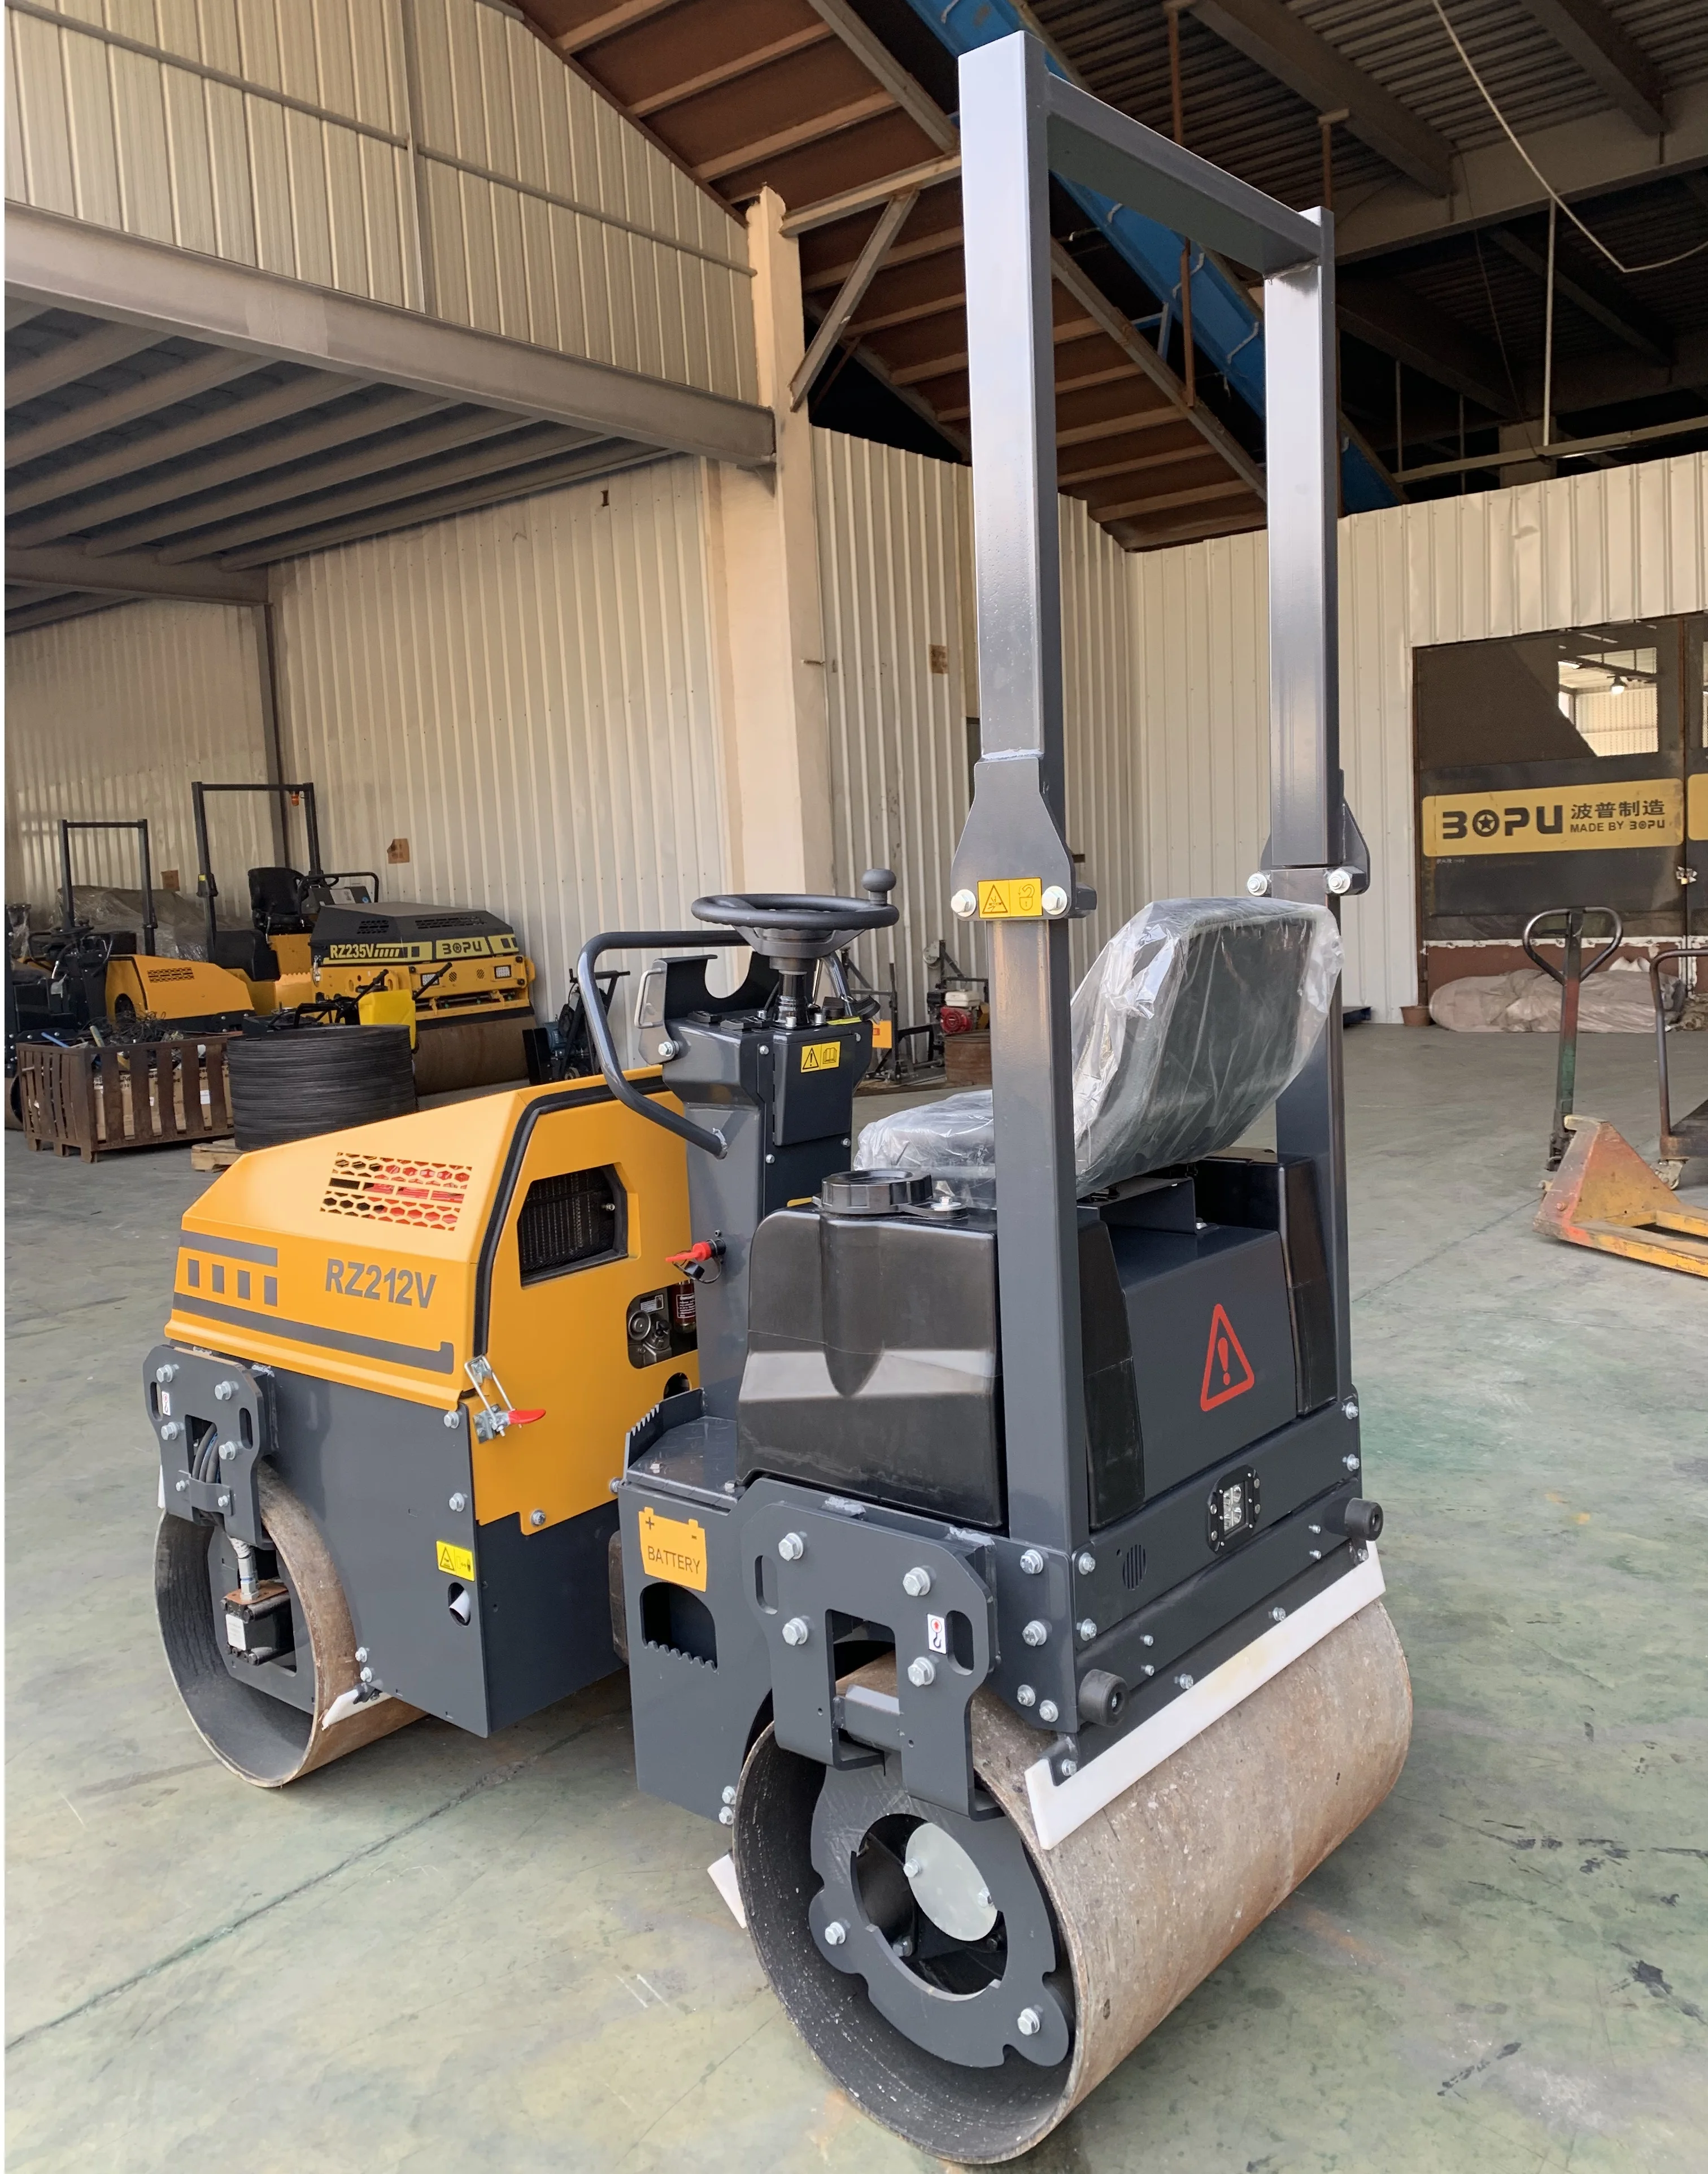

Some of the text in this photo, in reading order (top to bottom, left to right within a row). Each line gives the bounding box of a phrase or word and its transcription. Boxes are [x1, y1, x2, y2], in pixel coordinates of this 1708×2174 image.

[1570, 799, 1666, 820] 波普制造
[1570, 822, 1604, 833] MADE
[1608, 821, 1623, 831] BY
[330, 942, 375, 959] RZ235V
[325, 1258, 438, 1309] RZ212V
[648, 1545, 700, 1575] BATTERY
